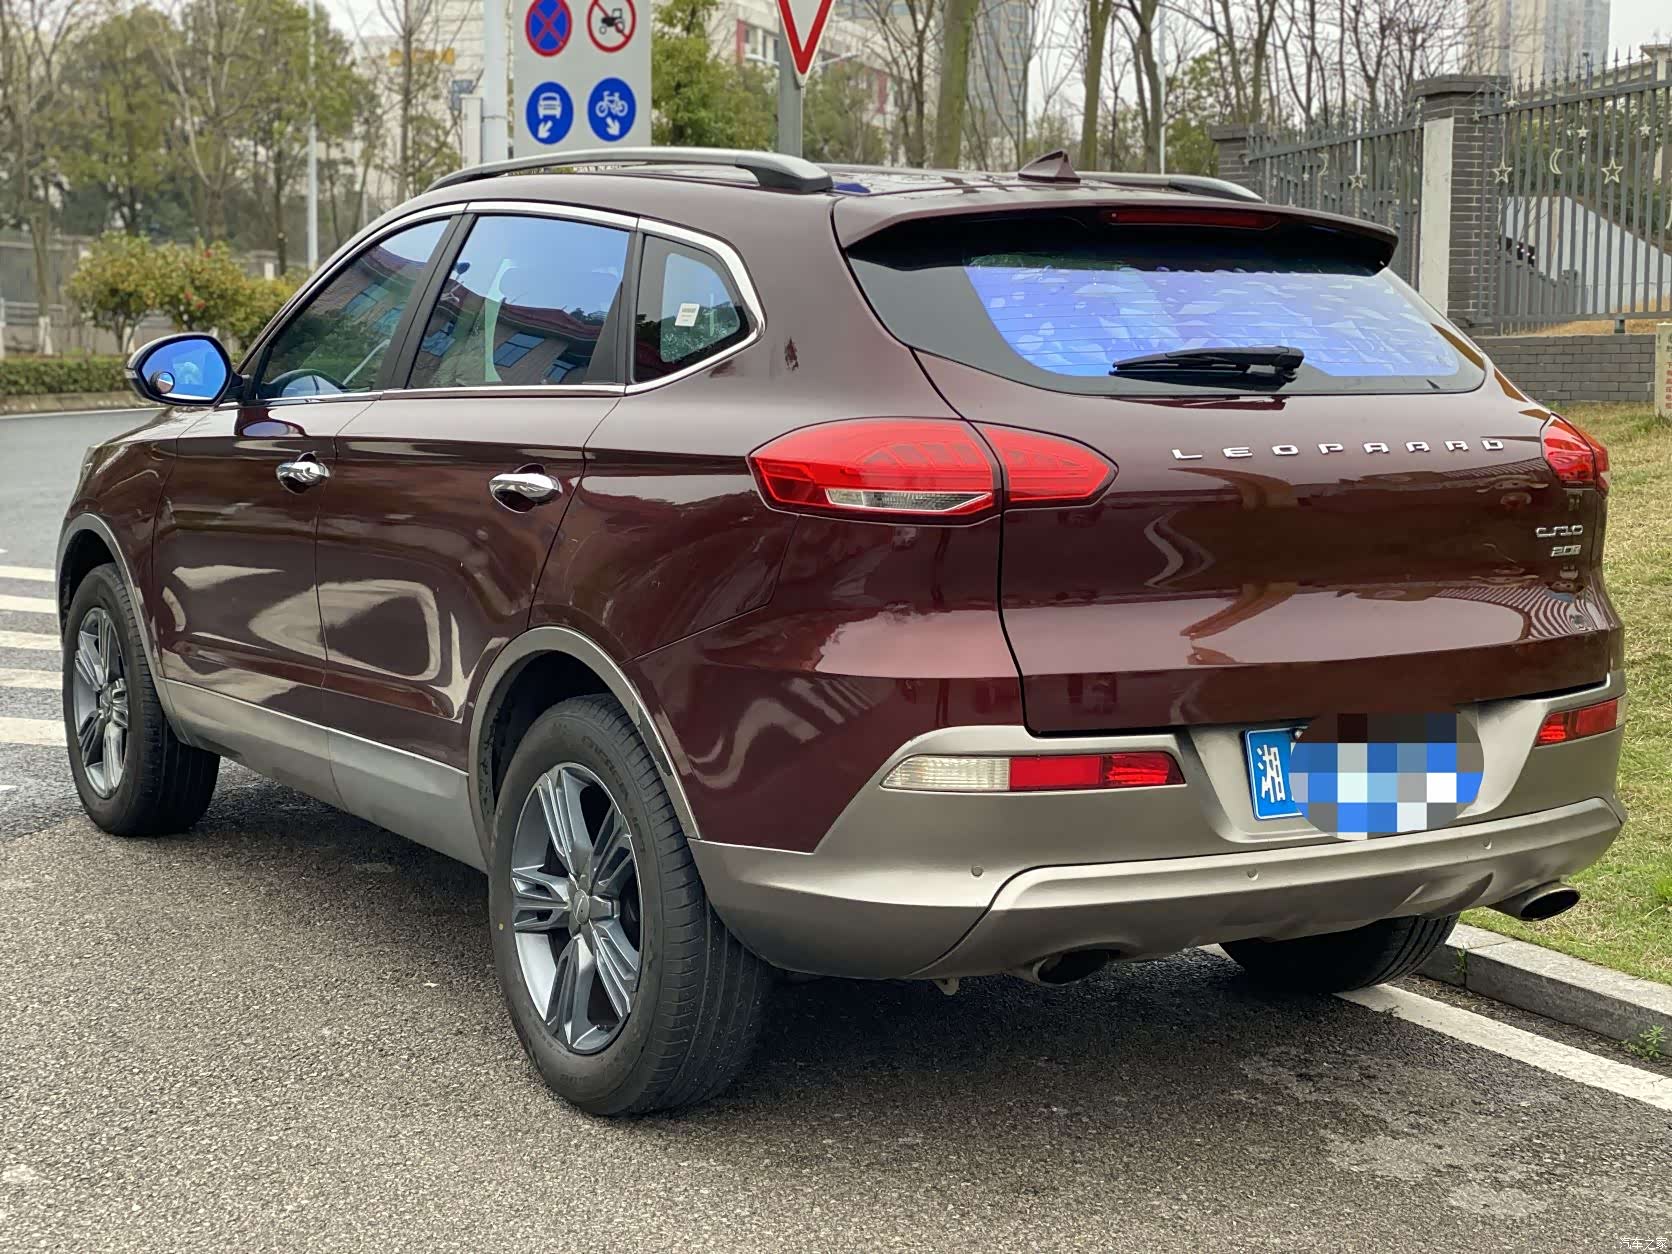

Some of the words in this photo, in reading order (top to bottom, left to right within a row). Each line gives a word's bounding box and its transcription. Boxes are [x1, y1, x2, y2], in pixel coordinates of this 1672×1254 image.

[1171, 439, 1505, 461] LEOPAARD
[1535, 524, 1584, 538] CS10
[1256, 744, 1286, 803] 湘
